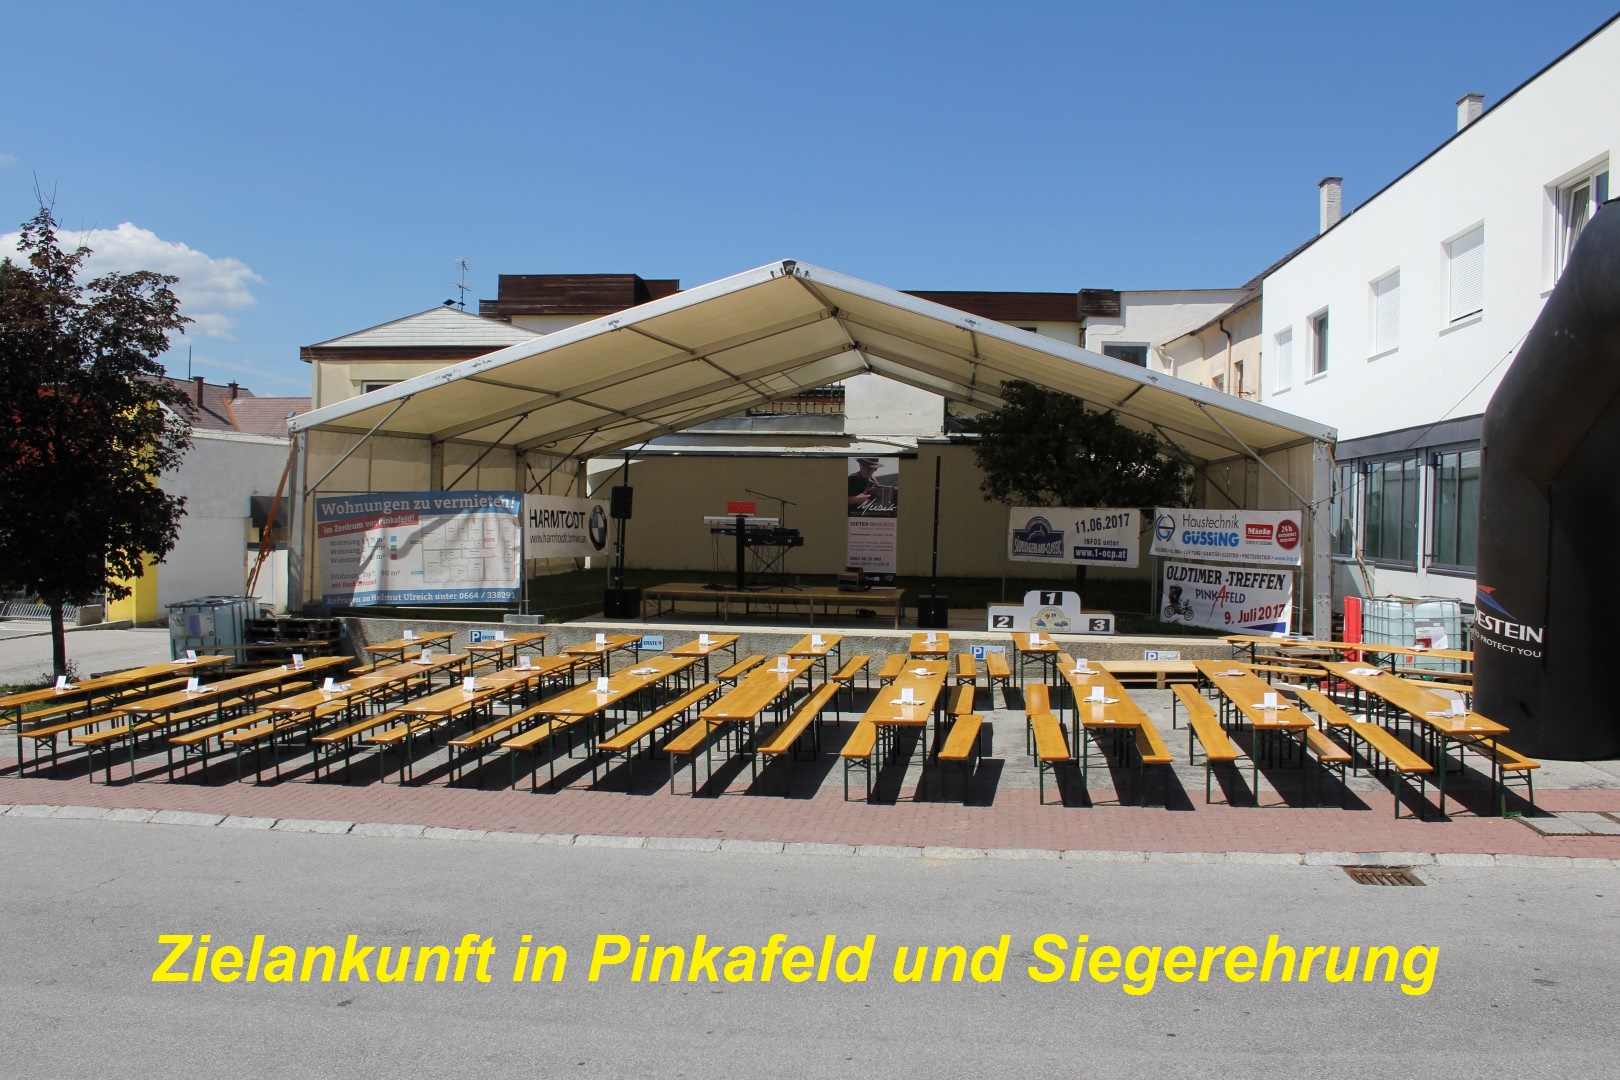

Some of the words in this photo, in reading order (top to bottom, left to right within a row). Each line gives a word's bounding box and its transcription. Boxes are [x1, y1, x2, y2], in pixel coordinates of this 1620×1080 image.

[320, 499, 410, 516] Wohnungen
[413, 499, 431, 510] zu
[433, 493, 516, 509] vermieten!
[857, 498, 897, 516] Musik
[334, 522, 364, 533] Zentrum
[378, 514, 415, 525] Pinkafeld!
[529, 508, 586, 529] HARMTODT
[1074, 512, 1130, 534] 11.06.2017
[1182, 513, 1240, 529] Haustechnik
[1247, 527, 1272, 535] Miele
[1084, 538, 1102, 546] INFOS
[1075, 548, 1126, 559] www.1-ocp.at
[1166, 565, 1222, 585] OLDTIMER
[1225, 570, 1286, 590] -TREFFEN
[371, 593, 402, 601] Helmut
[403, 592, 433, 601] Ulreich
[1046, 592, 1056, 605] 1
[1195, 585, 1246, 609] PINKAFELD
[996, 616, 1009, 628] 2
[1224, 611, 1235, 625] 9.
[1238, 607, 1257, 624] Juli
[1258, 603, 1286, 621] 2017
[1092, 619, 1106, 631] 3
[1480, 633, 1515, 653] PROTECT
[1516, 647, 1542, 659] YOU
